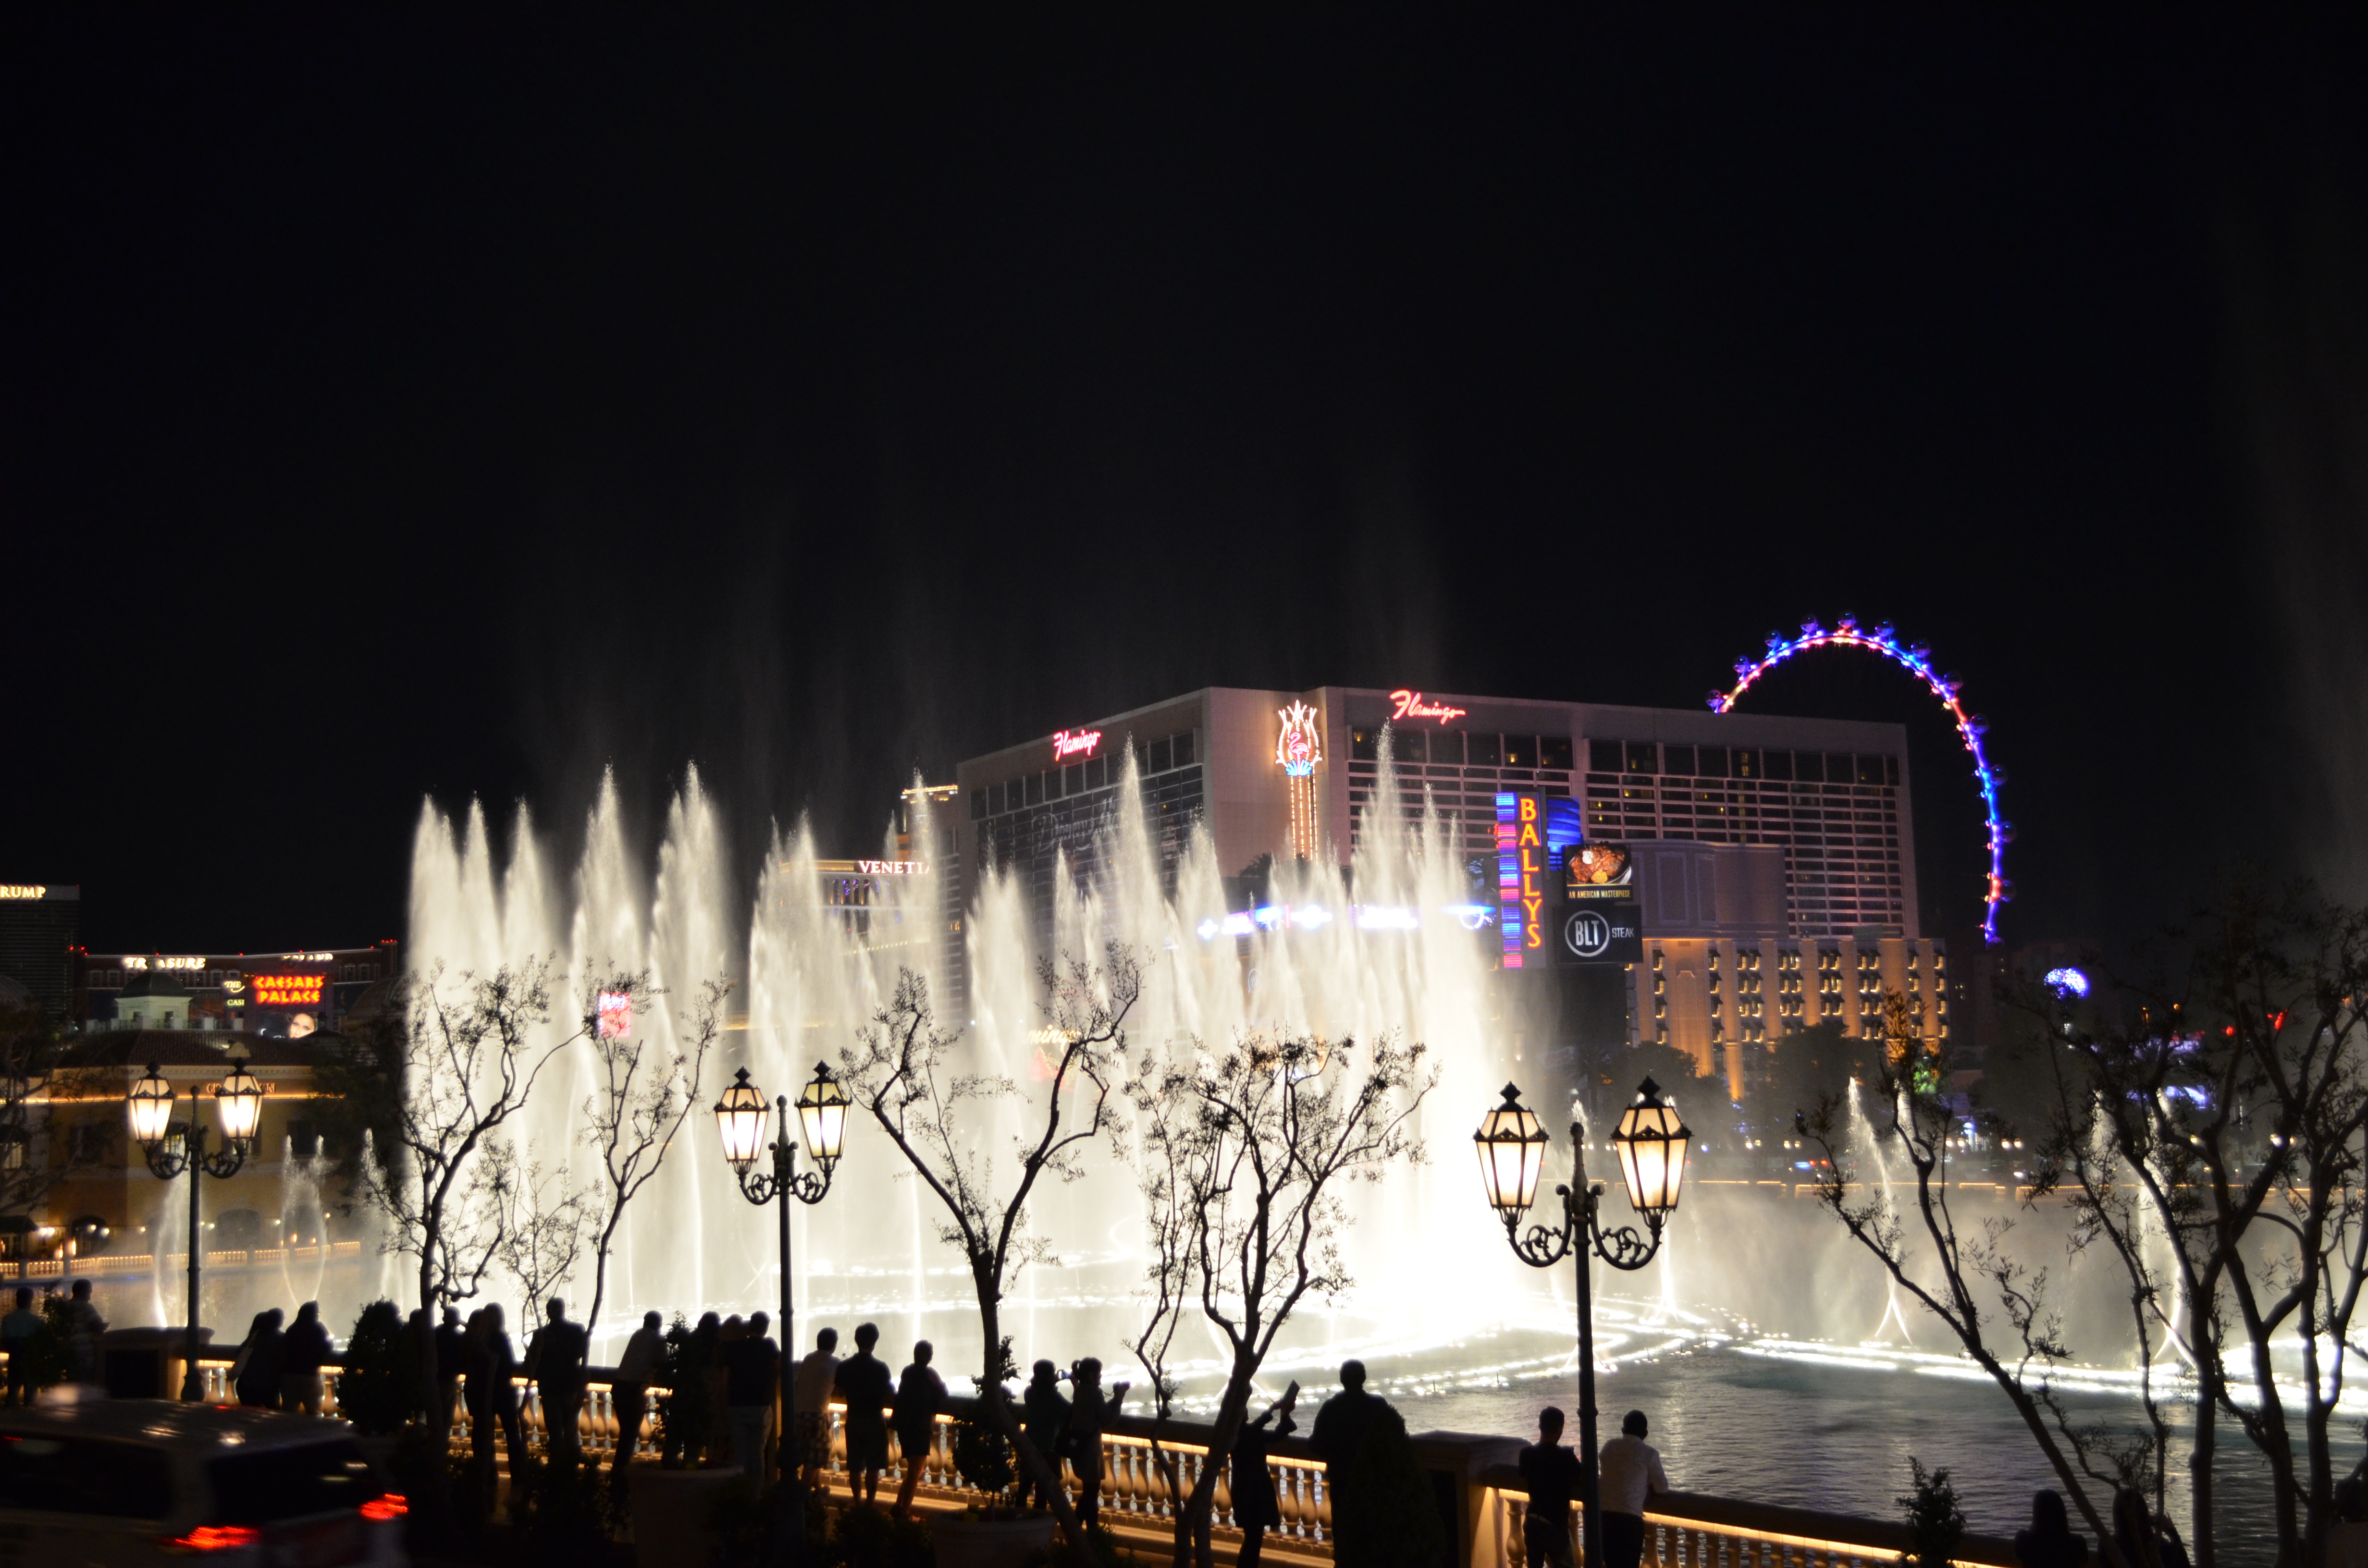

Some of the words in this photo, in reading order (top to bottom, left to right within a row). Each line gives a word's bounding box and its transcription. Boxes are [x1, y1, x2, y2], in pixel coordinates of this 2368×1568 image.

[1390, 689, 1466, 725] Flamingo
[1053, 729, 1101, 761] Flamingo
[1577, 890, 1600, 898] AMERICAN
[1601, 890, 1630, 898] MASTERPIECE
[1575, 920, 1600, 946] BLT
[1612, 928, 1634, 938] STEAK
[124, 957, 206, 969] TRASURE
[254, 976, 324, 990] CAESARS
[257, 990, 321, 1004] PALACE
